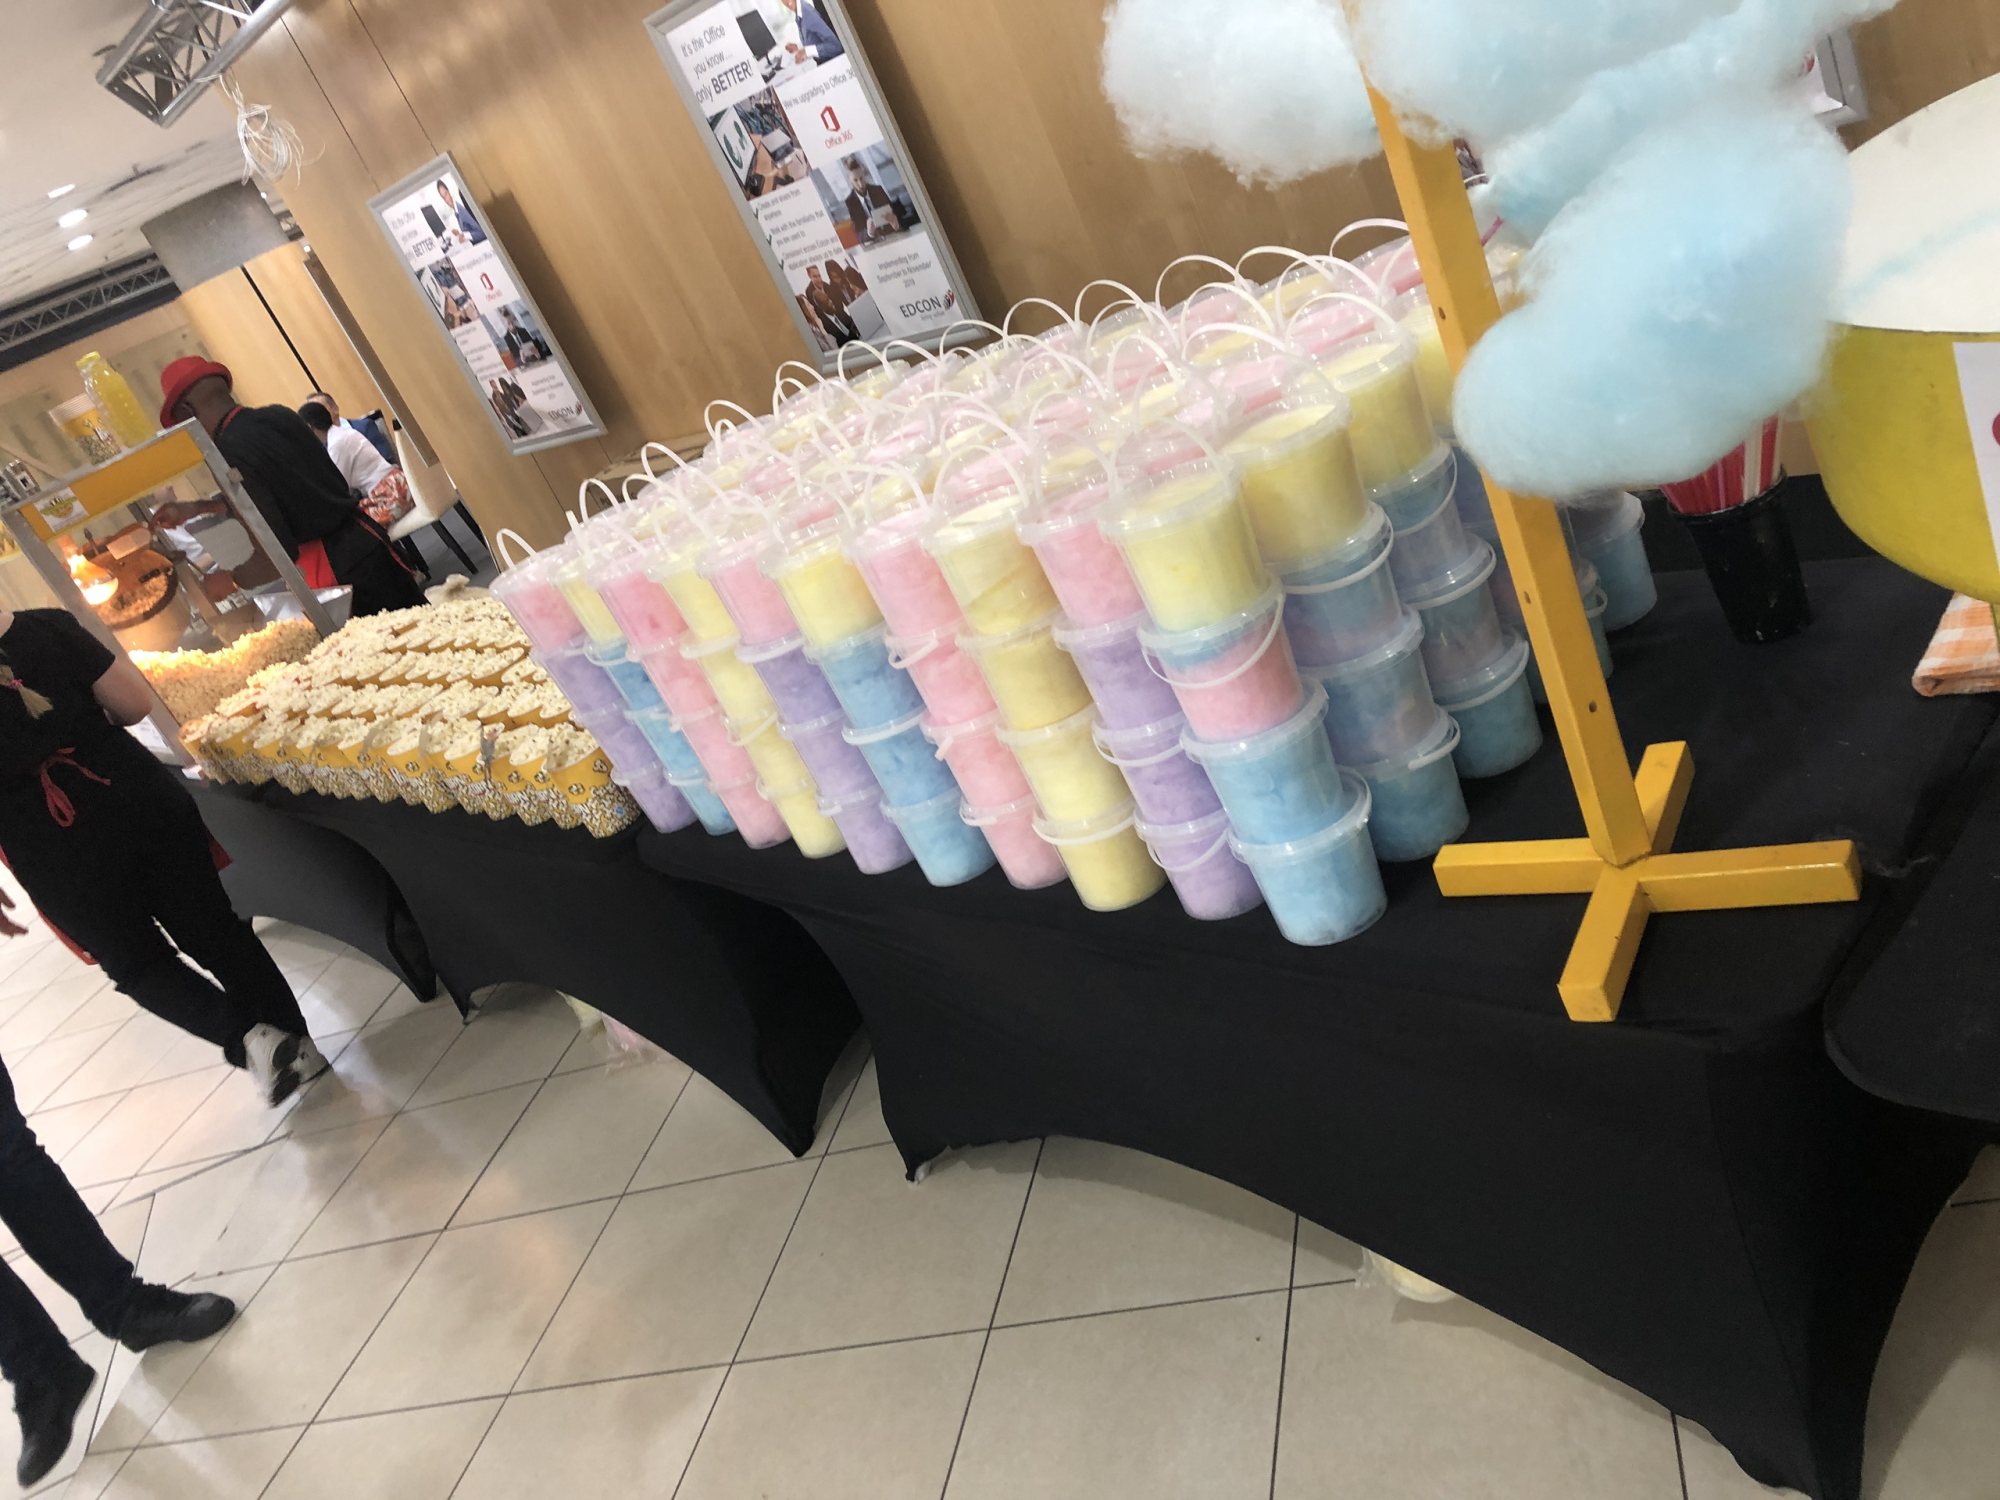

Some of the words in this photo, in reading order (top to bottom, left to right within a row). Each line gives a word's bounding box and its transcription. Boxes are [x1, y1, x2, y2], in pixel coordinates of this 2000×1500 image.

[692, 37, 704, 52] the
[703, 25, 726, 45] Office
[694, 62, 707, 80] you
[696, 84, 713, 104] only
[711, 59, 754, 94] BETTER!
[825, 135, 842, 149] Office
[899, 296, 942, 318] EDCON
